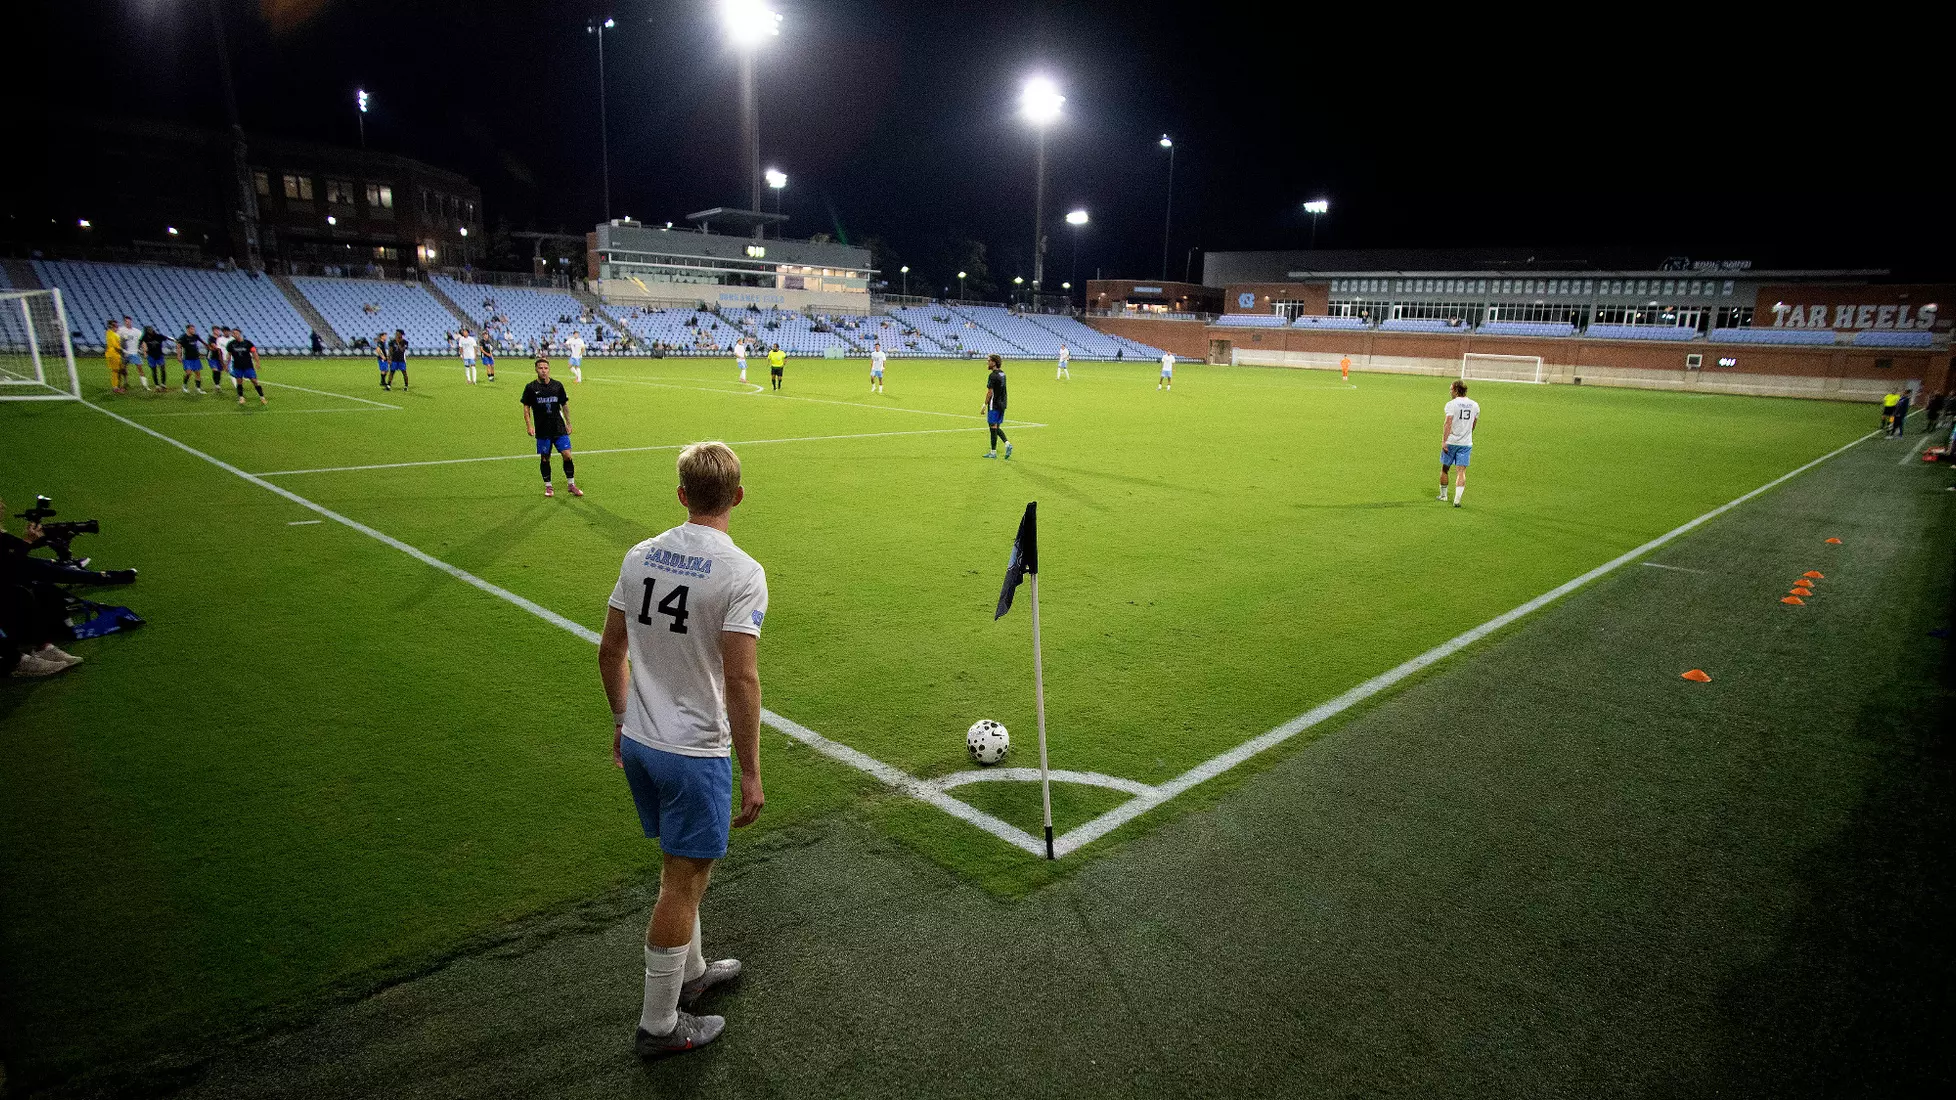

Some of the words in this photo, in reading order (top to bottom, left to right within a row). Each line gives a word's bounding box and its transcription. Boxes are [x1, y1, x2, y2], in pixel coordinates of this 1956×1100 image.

[1772, 304, 1828, 329] TAR
[1833, 303, 1938, 330] HEELS
[1459, 409, 1471, 420] 13
[638, 577, 690, 634] 14
